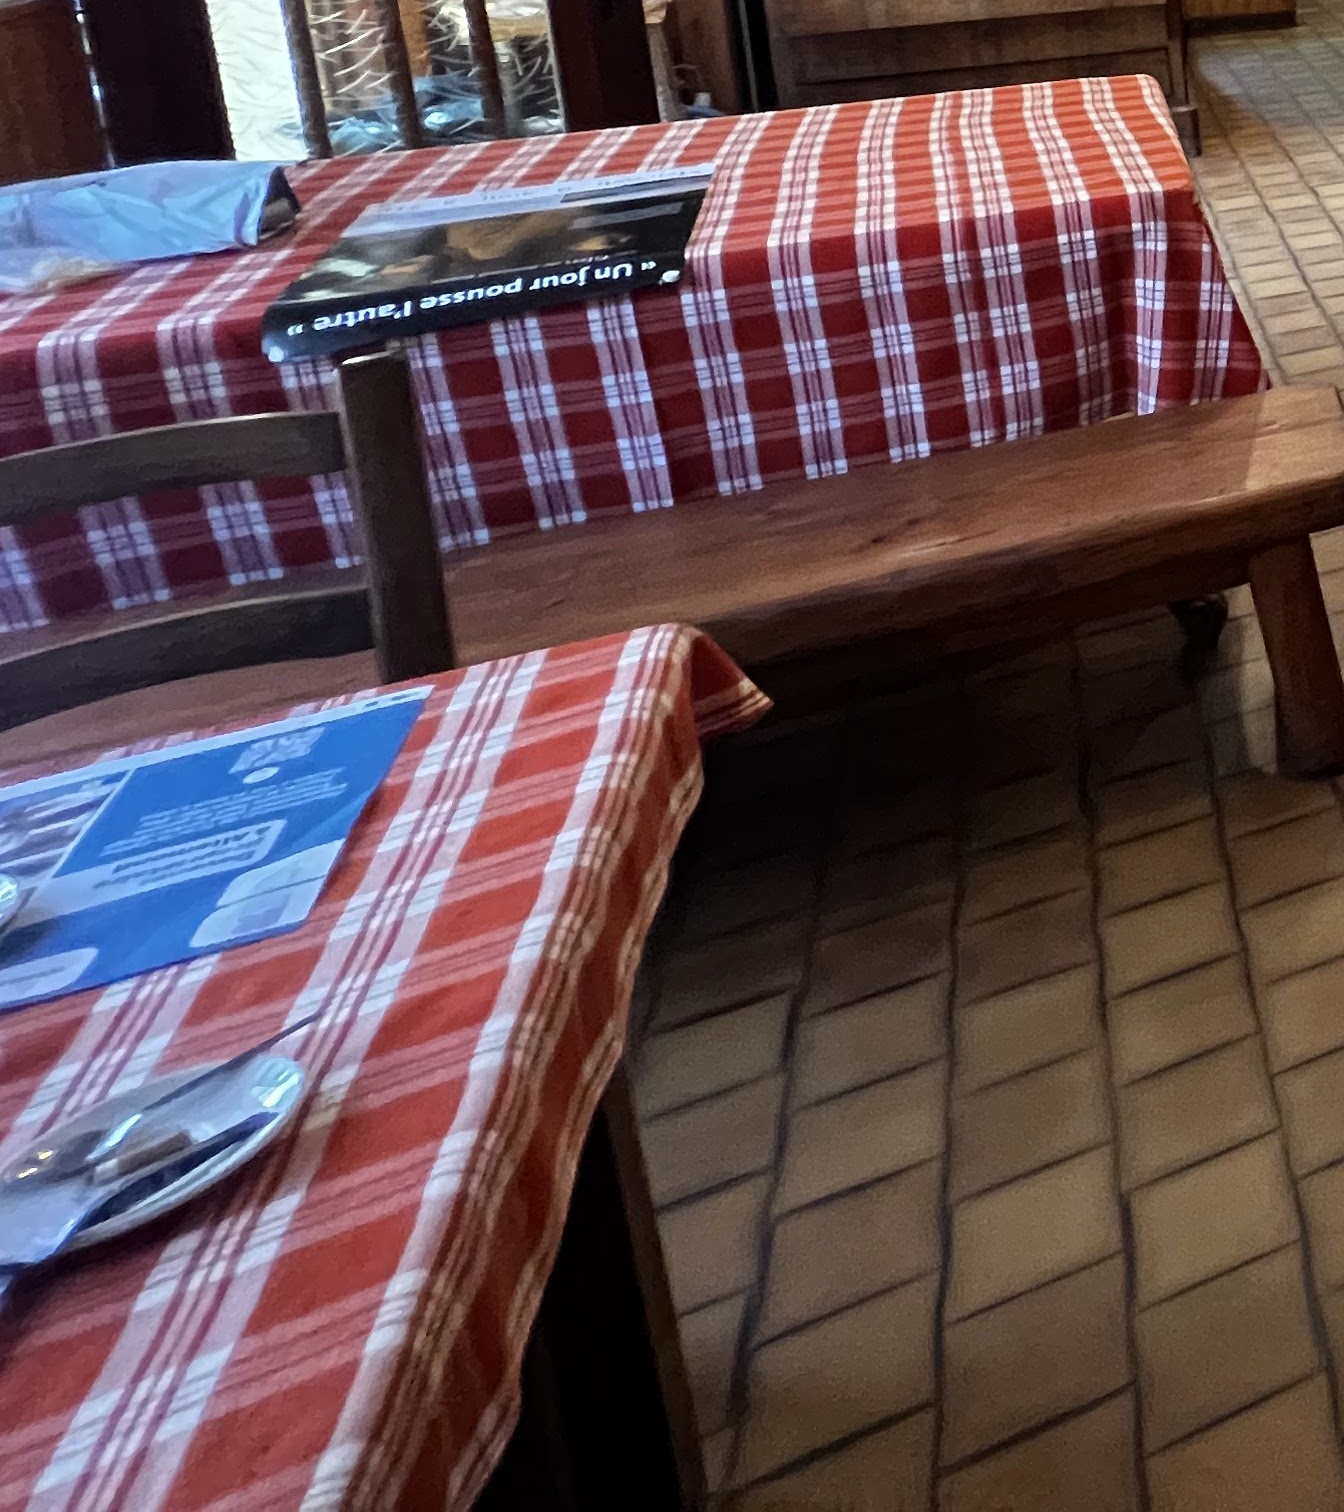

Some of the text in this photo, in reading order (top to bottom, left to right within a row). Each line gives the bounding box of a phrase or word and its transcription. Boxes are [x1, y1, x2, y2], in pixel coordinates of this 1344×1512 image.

[529, 264, 591, 291] jour
[594, 262, 633, 281] Un
[419, 277, 523, 311] pousse
[313, 299, 413, 332] l'autre
